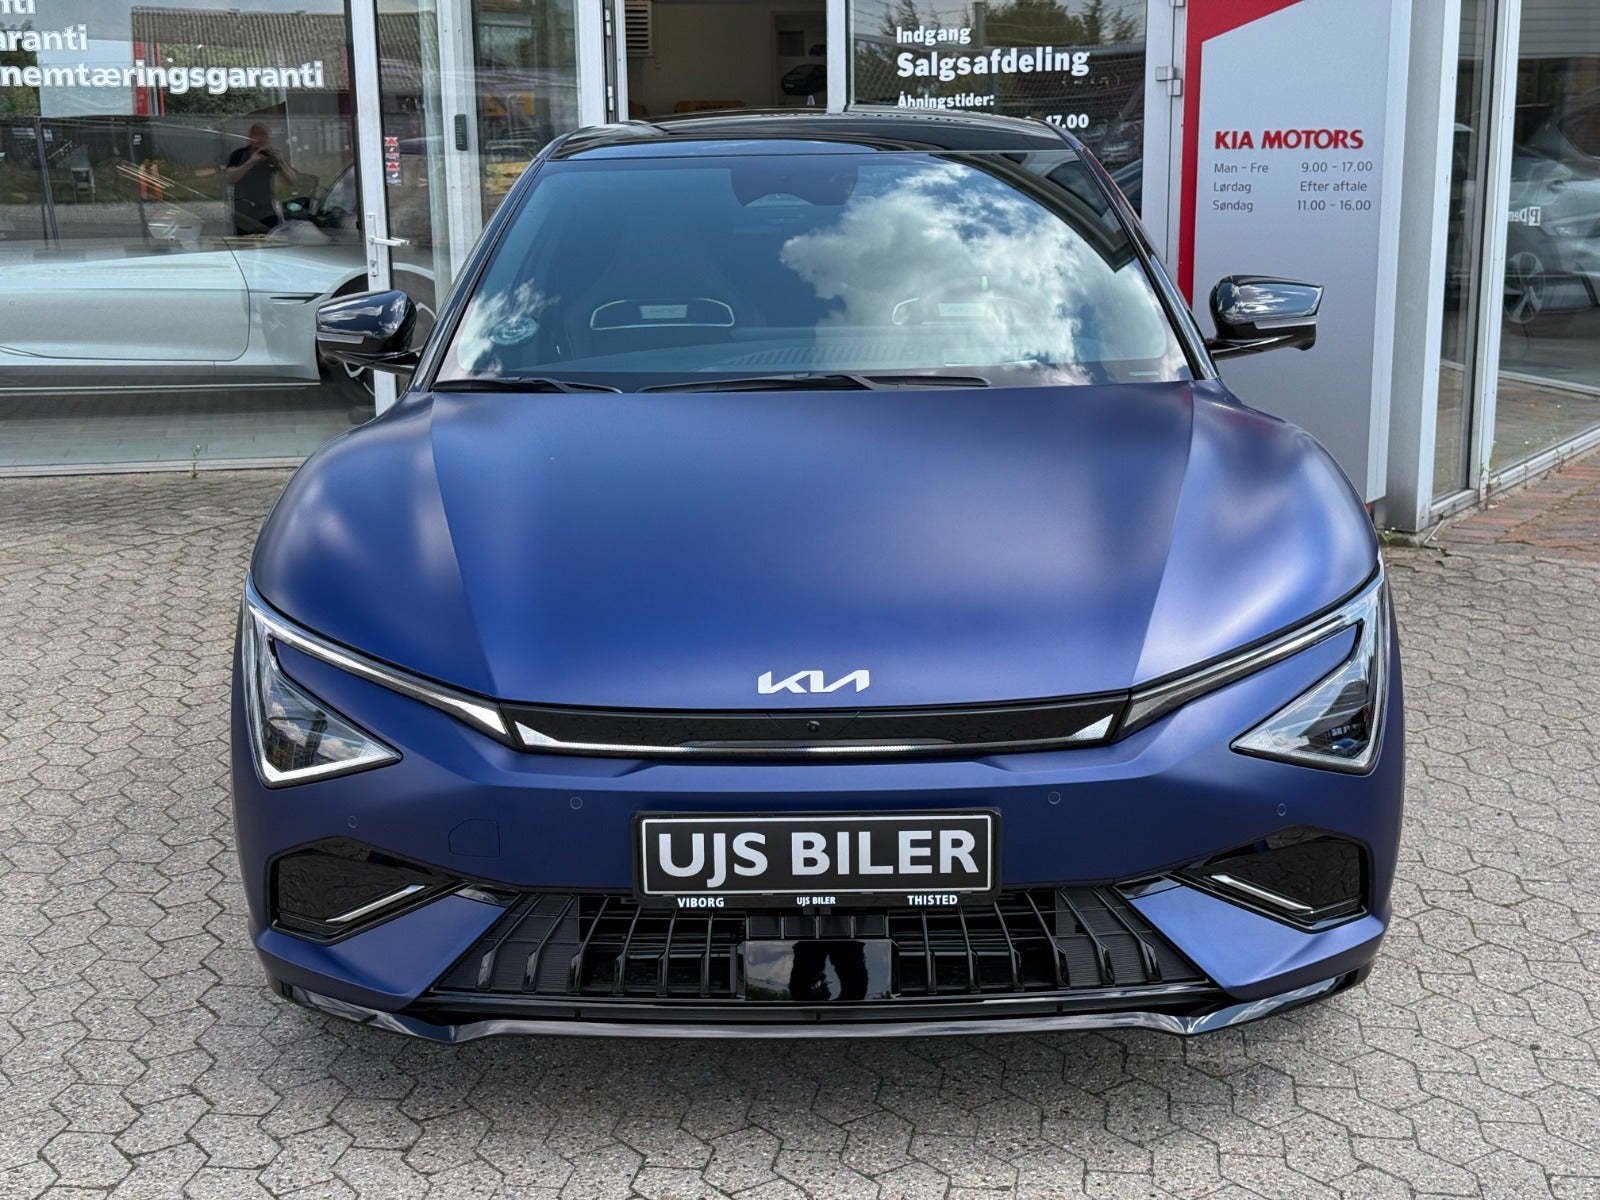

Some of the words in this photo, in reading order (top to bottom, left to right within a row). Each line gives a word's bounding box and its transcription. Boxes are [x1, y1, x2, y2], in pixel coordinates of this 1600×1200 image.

[896, 26, 972, 45] Indgang
[896, 46, 1091, 82] Salgsafdeling
[1214, 130, 1254, 150] KIA
[1261, 129, 1364, 149] MOTORS
[1214, 163, 1238, 173] Man
[1250, 162, 1269, 173] Fre
[1301, 161, 1328, 173] 9.00
[1342, 161, 1373, 173] 17.00
[1213, 181, 1252, 194] Lørdag
[1300, 181, 1330, 192] Efter
[1333, 181, 1368, 192] aftale
[1213, 200, 1254, 213] Søndag
[1297, 200, 1326, 211] 11.00
[1340, 200, 1372, 211] 16.00
[658, 832, 769, 888] UJS
[791, 829, 979, 876] BILER
[677, 897, 725, 908] VIBORG
[796, 896, 811, 905] UJS
[813, 896, 836, 905] BILER
[907, 894, 958, 906] THISTED
